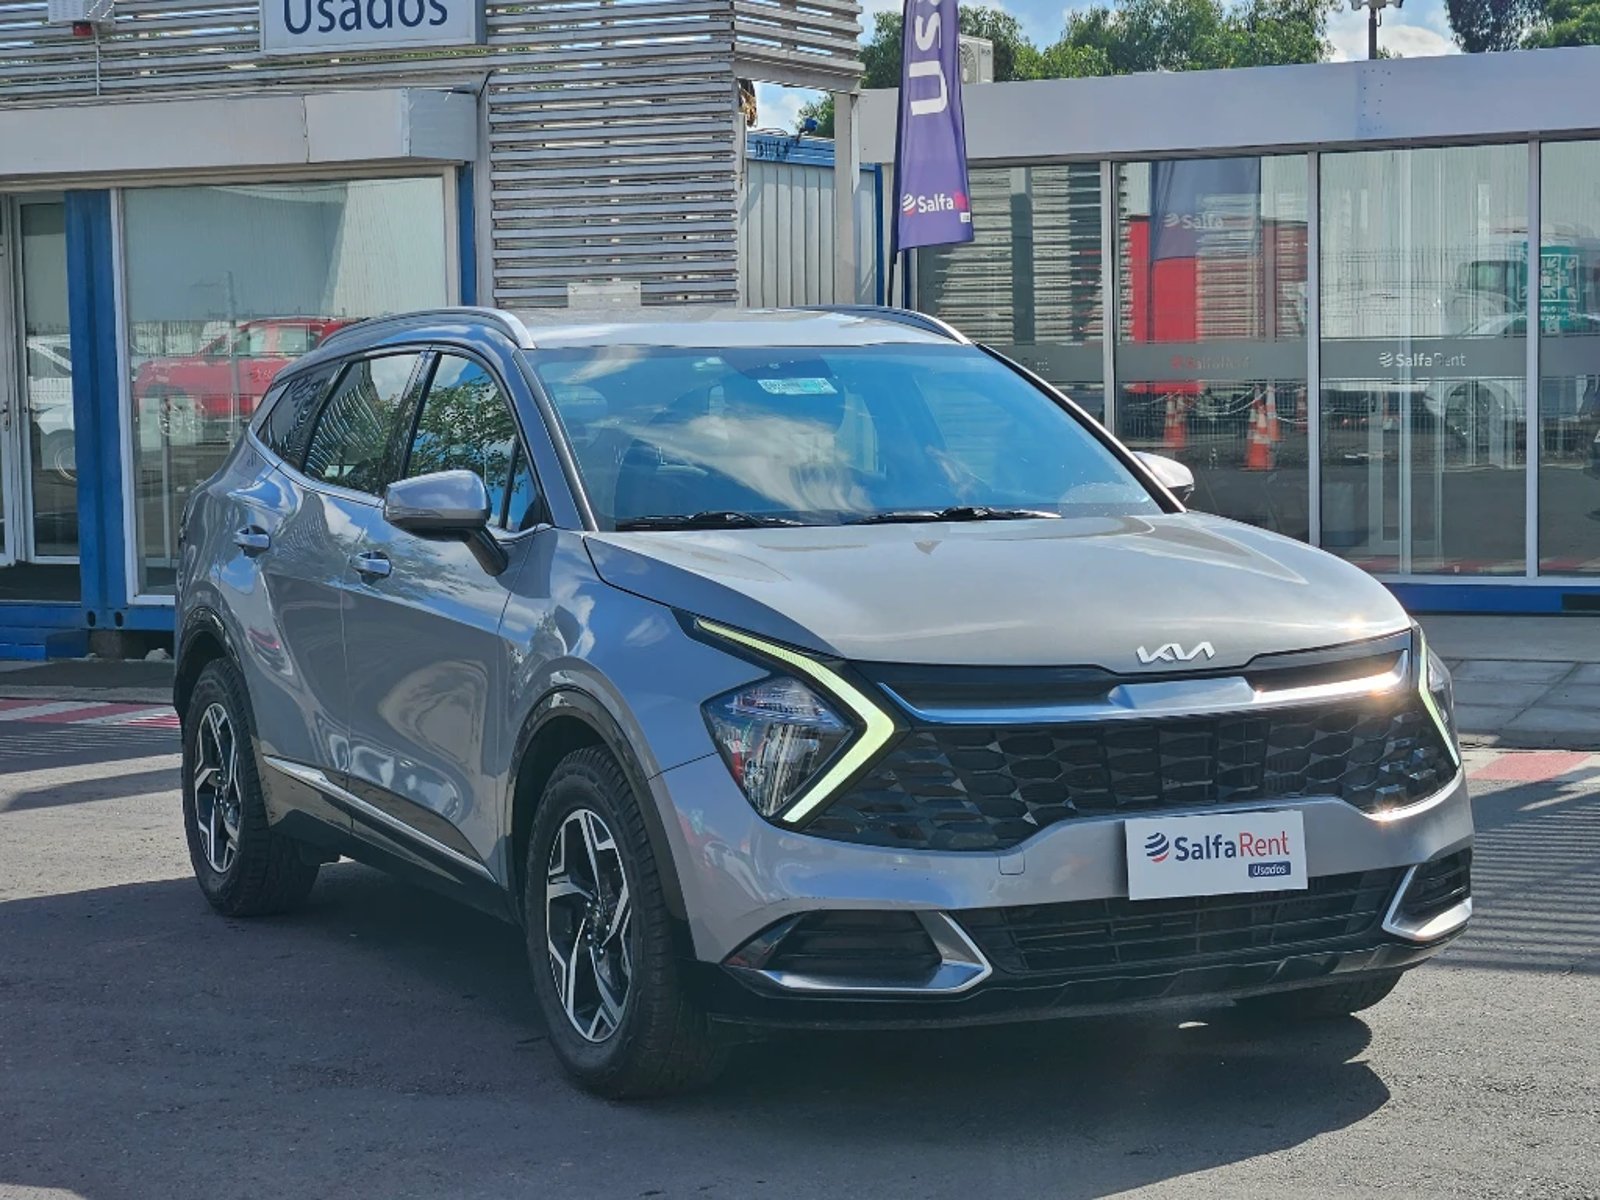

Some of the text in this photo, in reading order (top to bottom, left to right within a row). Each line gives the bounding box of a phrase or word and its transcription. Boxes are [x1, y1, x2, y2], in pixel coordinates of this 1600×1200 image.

[283, 0, 449, 35] Usados
[908, 0, 948, 117] Us
[1174, 830, 1290, 862] SalfaRent
[1252, 863, 1287, 877] Usados
